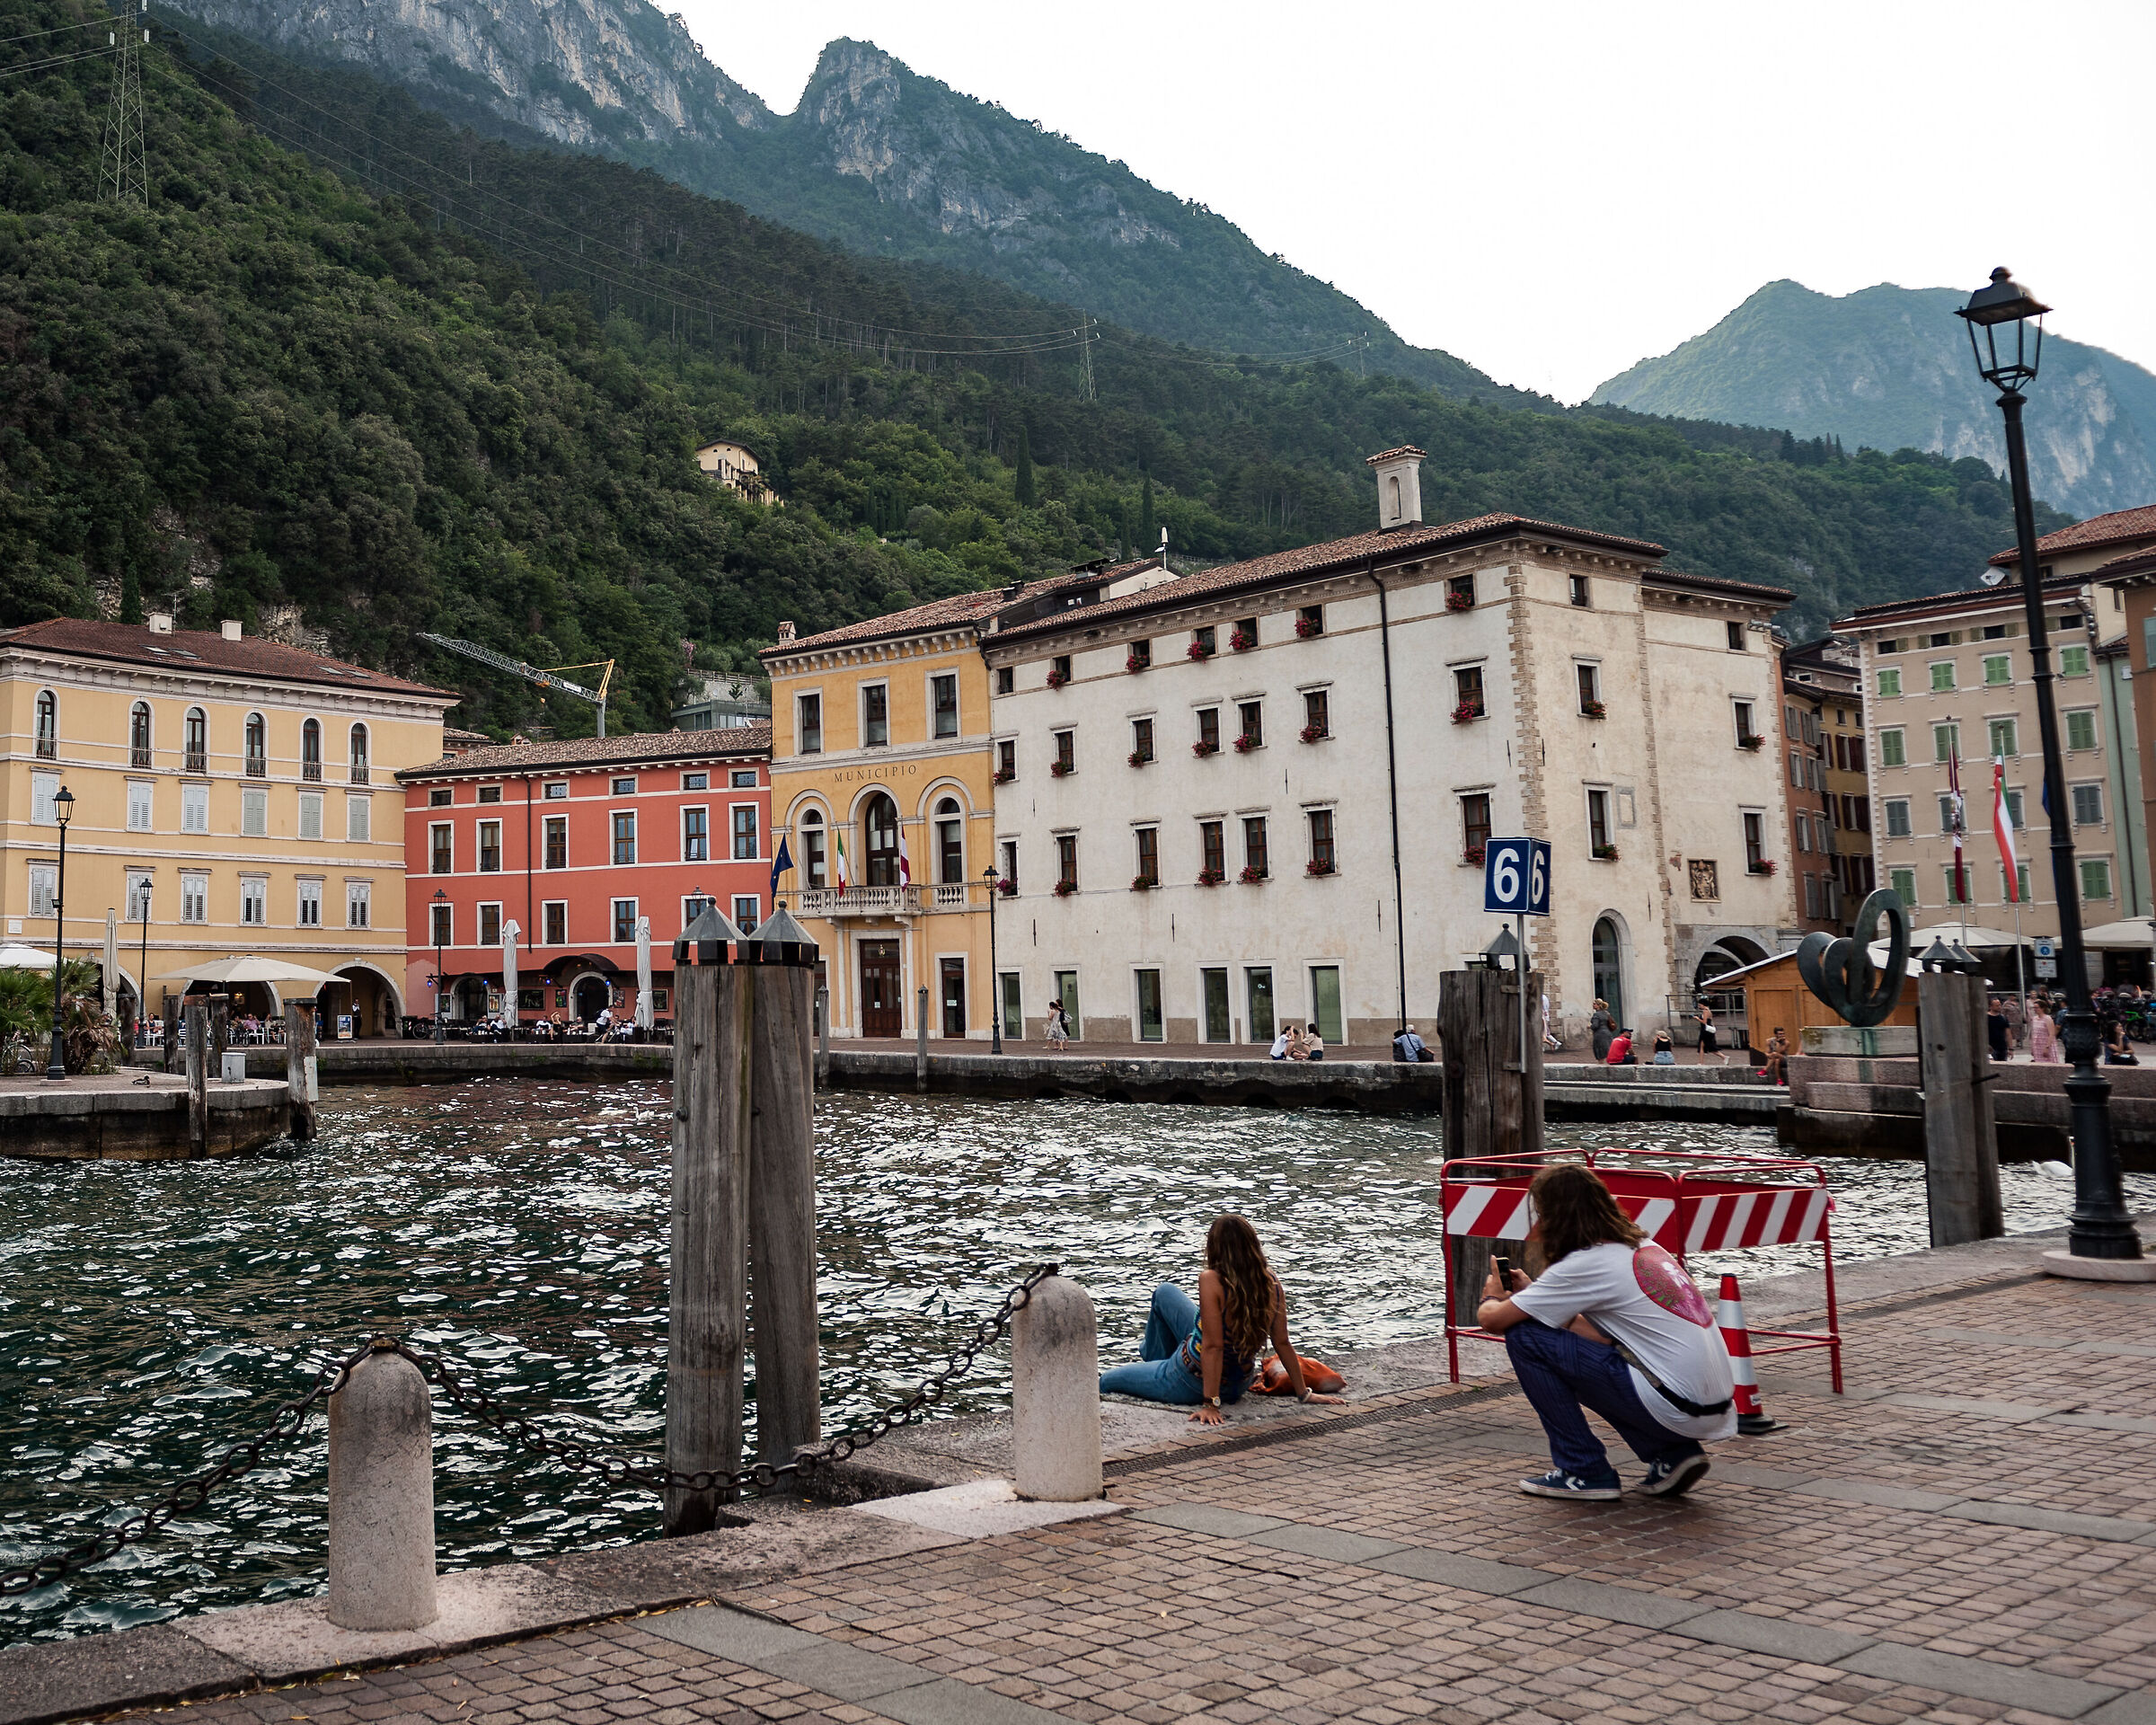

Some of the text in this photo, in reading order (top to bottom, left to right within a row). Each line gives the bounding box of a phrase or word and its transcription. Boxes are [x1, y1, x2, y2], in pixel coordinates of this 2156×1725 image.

[834, 765, 917, 783] MUNICIPIO
[1494, 847, 1520, 903] 6
[1532, 849, 1545, 905] 6
